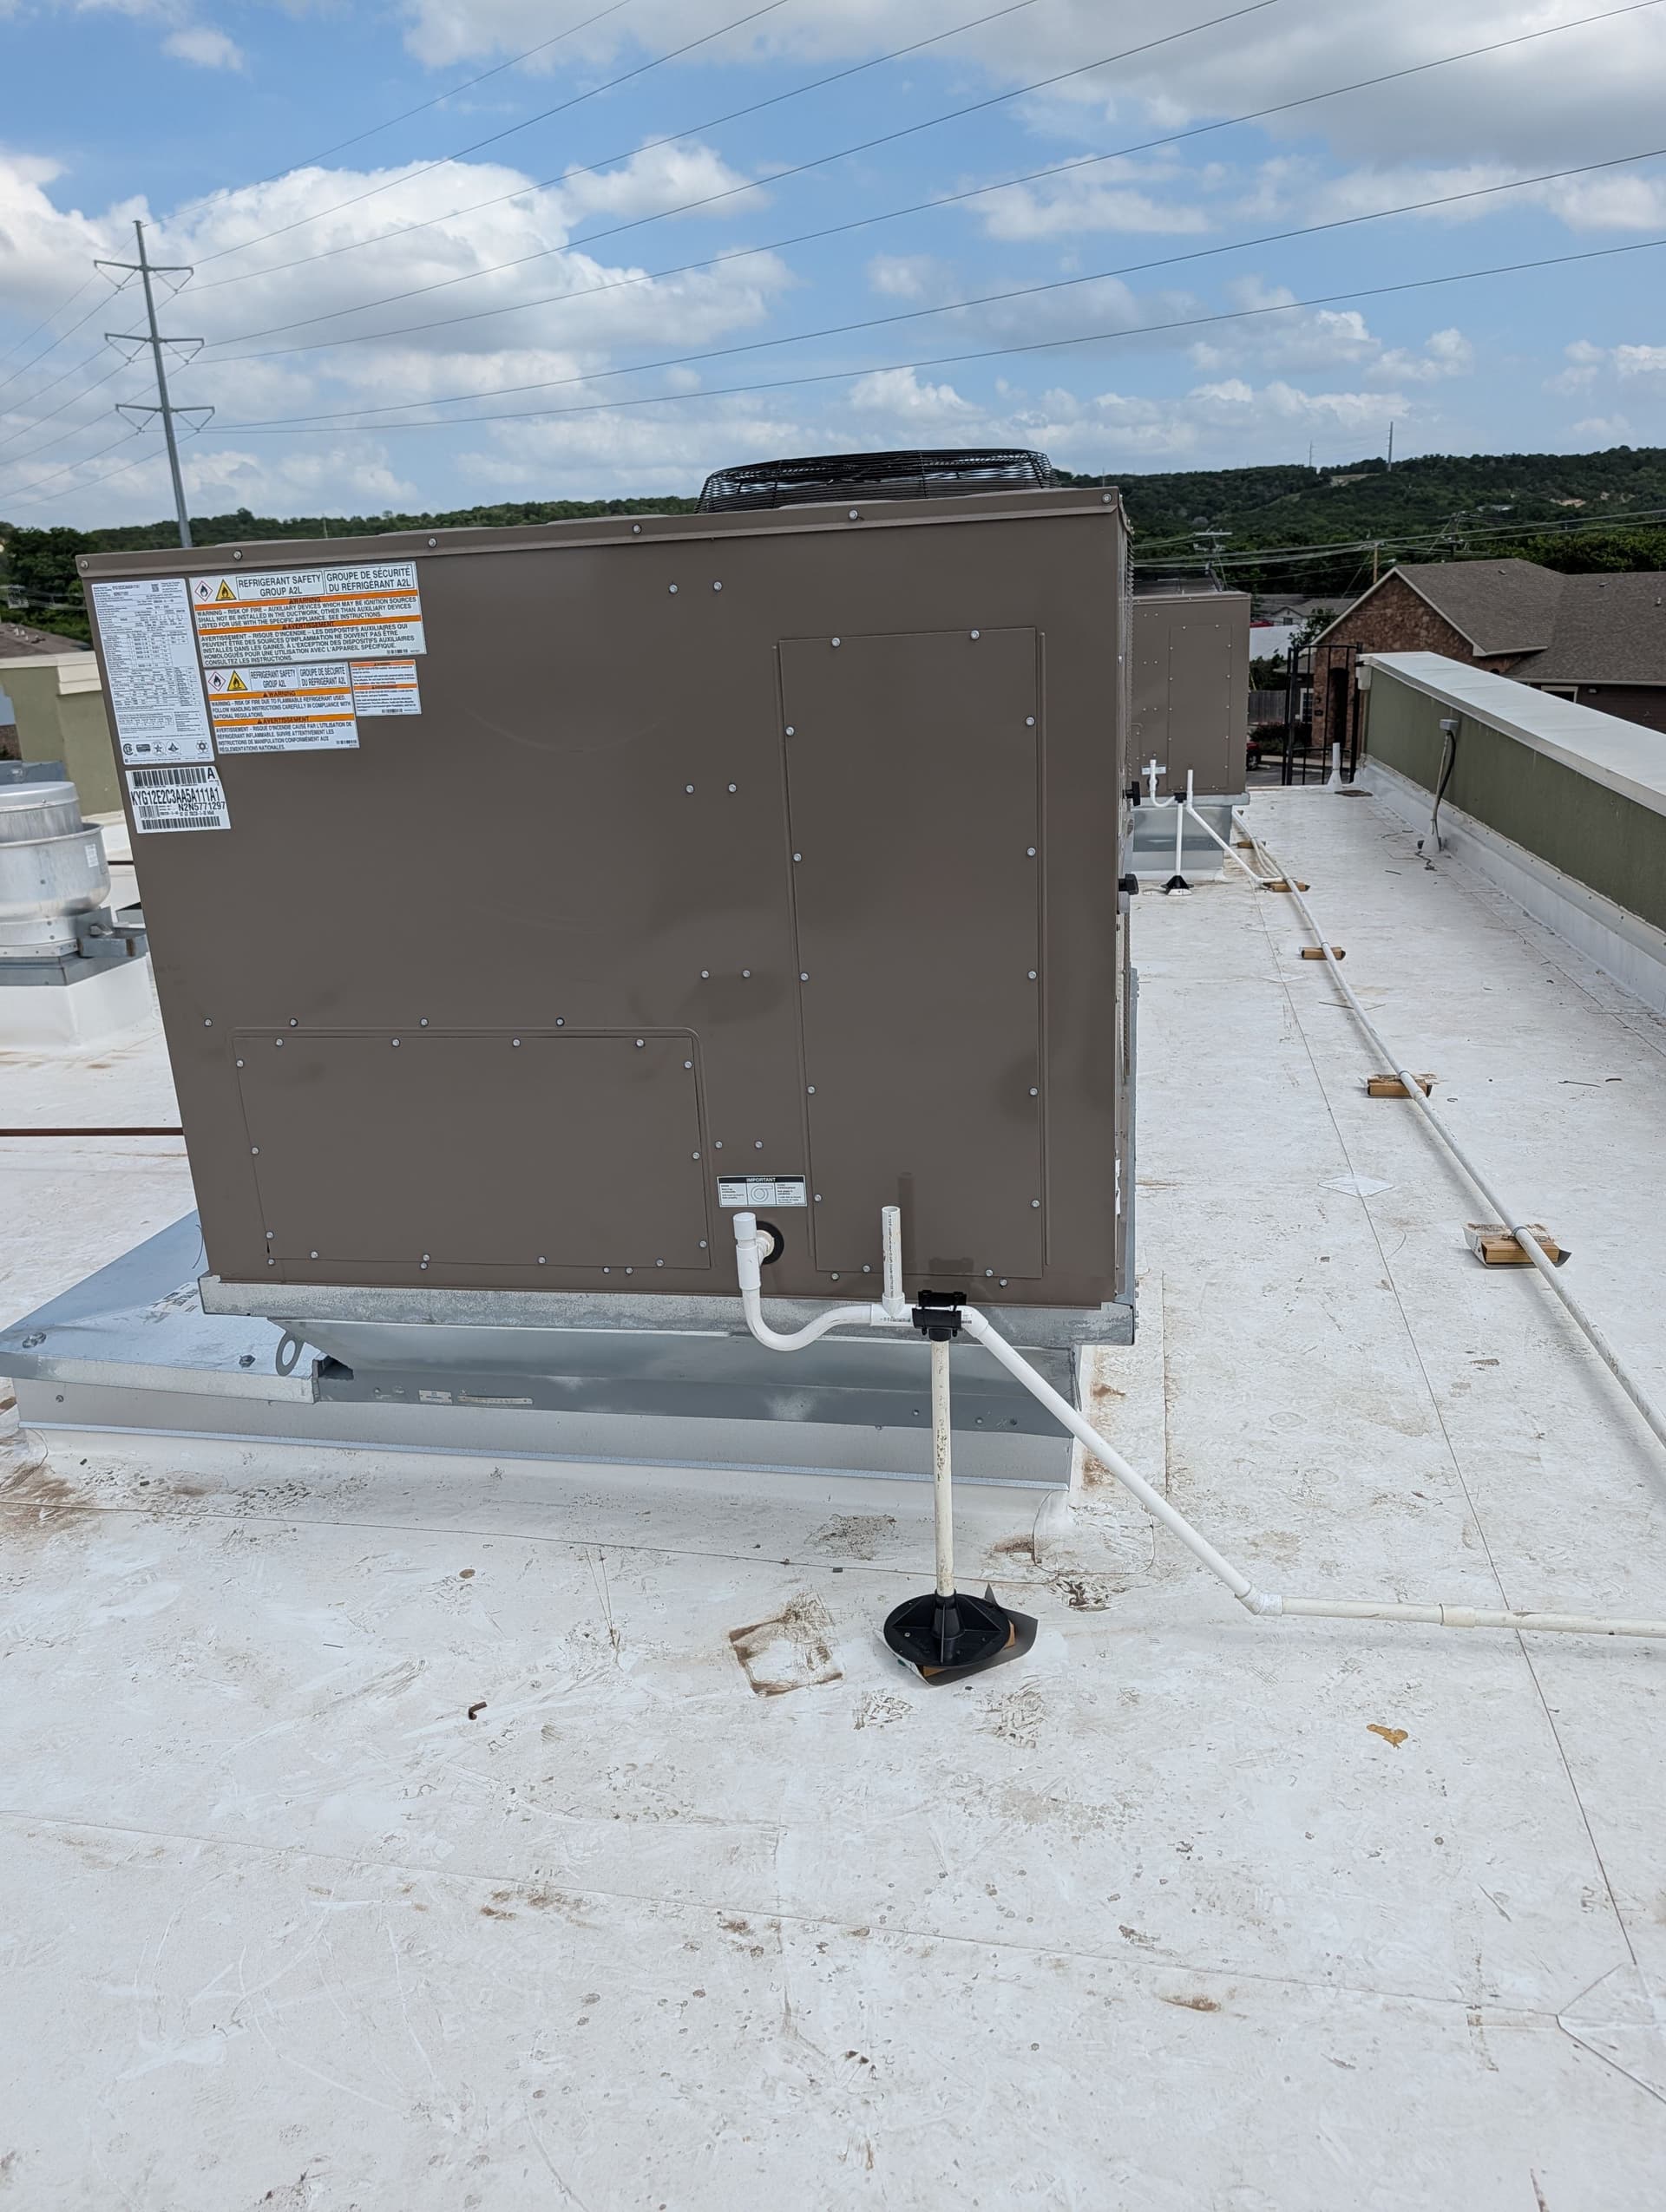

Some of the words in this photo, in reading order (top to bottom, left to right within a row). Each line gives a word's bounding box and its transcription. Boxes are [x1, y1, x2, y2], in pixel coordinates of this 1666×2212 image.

[326, 572, 359, 581] GROUPE
[360, 571, 371, 579] DE
[372, 566, 410, 579] SÉCURITÉ
[239, 577, 290, 588] REFRIGERANT
[292, 574, 321, 584] SAFETY
[341, 578, 395, 591] RÉFRIGÉRANT
[397, 579, 411, 587] A2L
[259, 587, 286, 597] GROUP
[288, 586, 302, 595] A2L
[208, 768, 215, 779] A
[131, 787, 220, 805] KYG12E2C3AA5A111A1
[178, 802, 225, 811] N2N5771297
